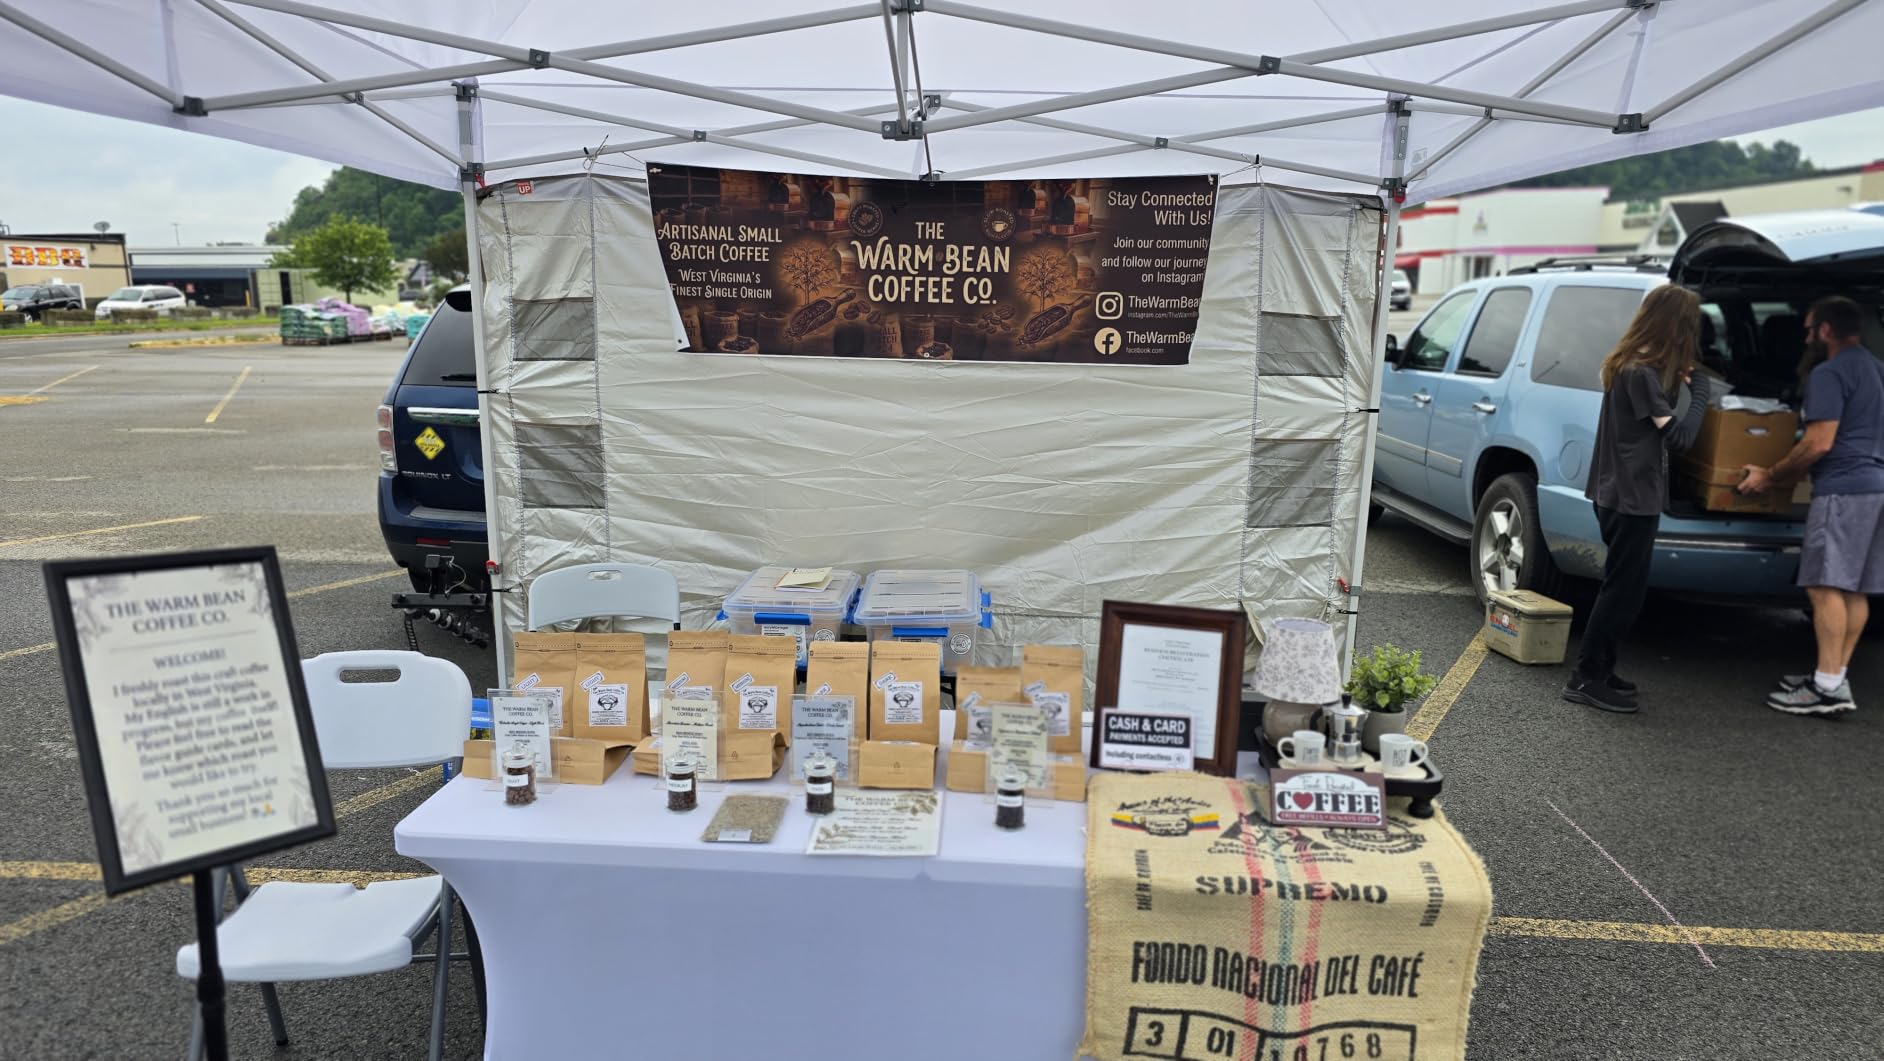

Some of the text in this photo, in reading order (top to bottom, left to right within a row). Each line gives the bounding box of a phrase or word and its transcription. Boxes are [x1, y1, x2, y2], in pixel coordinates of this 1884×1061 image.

[518, 185, 531, 194] UP
[1108, 190, 1213, 209] Stay Connected
[1154, 210, 1211, 226] With Us!
[658, 222, 782, 242] ARTISANAL SMALL
[915, 222, 945, 240] THE
[670, 242, 770, 262] BATCH COFFEE
[1114, 236, 1209, 250] Join our community
[851, 236, 1010, 274] WARM BEAN
[1102, 256, 1207, 270] and follow our journey
[678, 268, 760, 284] WEST VIRGINIA'S
[1142, 274, 1154, 282] on
[670, 284, 772, 299] FINEST SINGLE ORIGIN
[868, 274, 954, 304] COFFEE
[1128, 296, 1200, 308] TheWarmBea
[105, 590, 246, 618] THE WARM BEAN
[132, 610, 229, 634] COFFEE CO.
[154, 649, 226, 669] WELCOME!
[1108, 716, 1186, 733] CASH & CARD
[1109, 732, 1184, 746] PAYMENTS ACCEPTED
[1136, 752, 1172, 761] contactless
[1196, 876, 1388, 904] SUPREMO
[1131, 941, 1425, 1007] FONDO NACIONAL DEL CAFÉ
[1146, 1021, 1164, 1046] 3
[1207, 1027, 1235, 1057] 01
